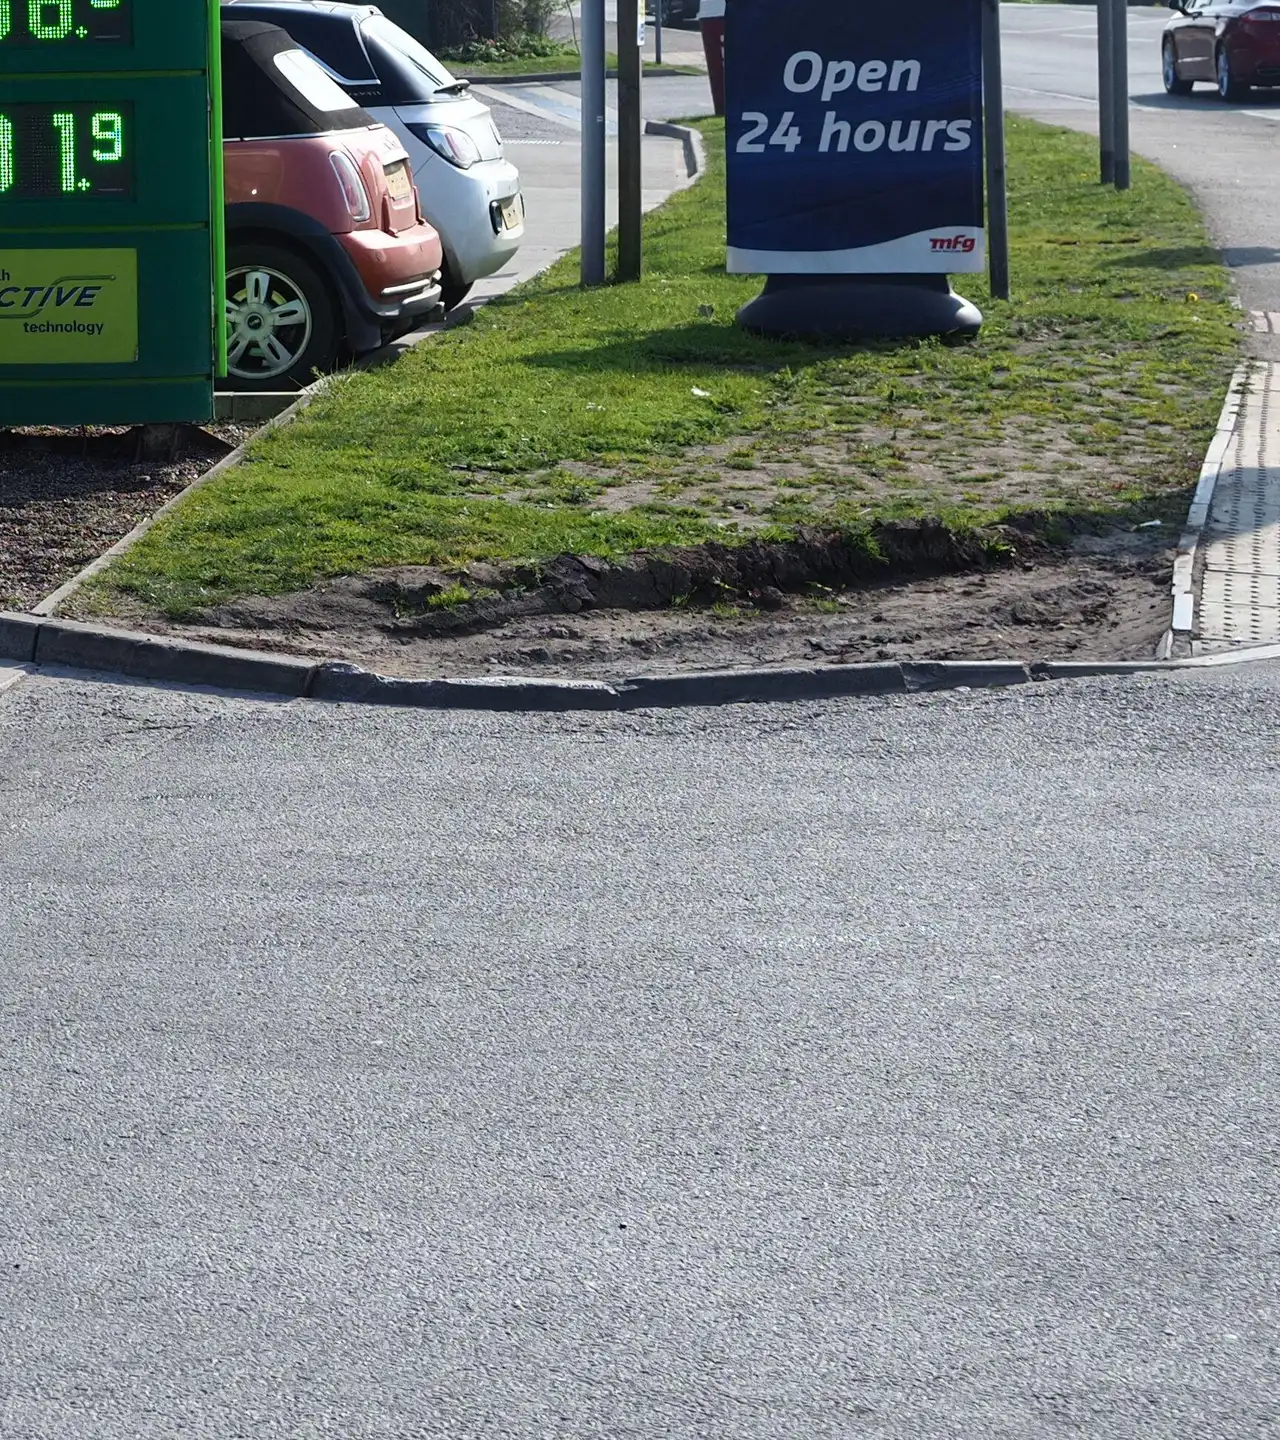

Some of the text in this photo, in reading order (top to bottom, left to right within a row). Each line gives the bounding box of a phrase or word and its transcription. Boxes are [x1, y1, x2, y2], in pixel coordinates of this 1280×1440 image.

[783, 50, 921, 101] Open
[736, 110, 972, 153] 24 hours
[929, 235, 976, 253] mfg
[23, 321, 104, 336] technology
